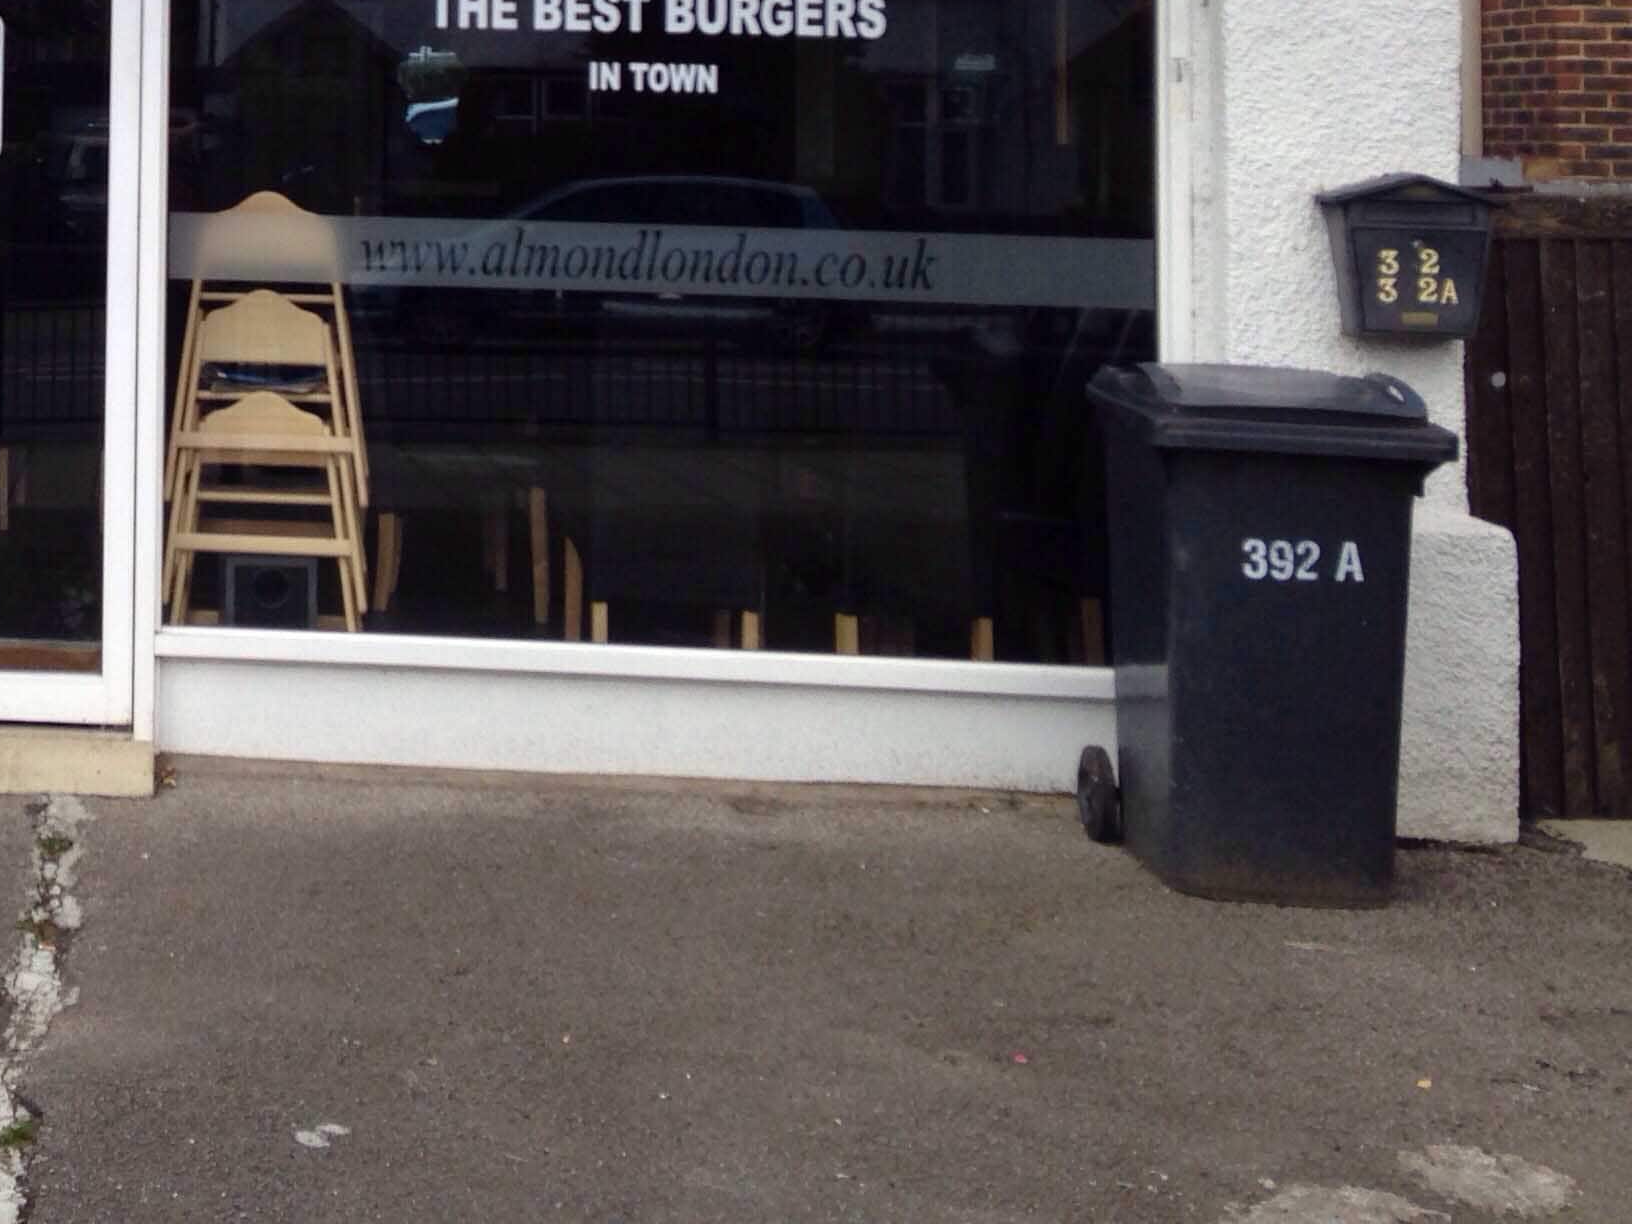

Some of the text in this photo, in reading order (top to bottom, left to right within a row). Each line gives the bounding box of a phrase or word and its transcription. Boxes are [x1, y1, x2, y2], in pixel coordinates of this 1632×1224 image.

[589, 61, 719, 94] IN TOWN
[360, 226, 940, 291] www.almondlondon.co.uk
[1241, 538, 1365, 582] 392 A
